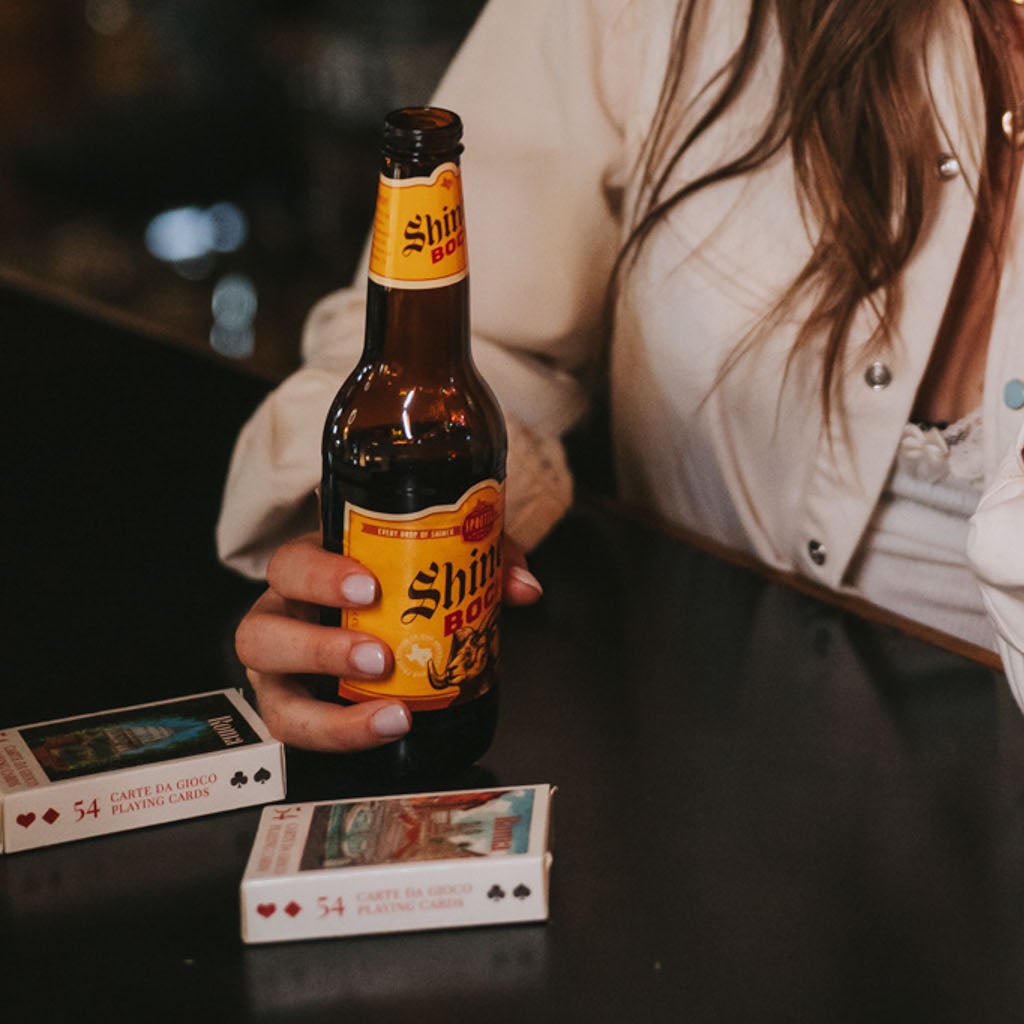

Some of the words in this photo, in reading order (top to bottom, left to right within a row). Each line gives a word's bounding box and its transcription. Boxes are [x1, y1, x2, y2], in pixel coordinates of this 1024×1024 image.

[73, 798, 101, 822] 54
[110, 785, 151, 803] CARTE
[155, 781, 174, 795] DA
[176, 773, 218, 790] GIOCO
[111, 796, 164, 816] PLAYING
[168, 786, 210, 805] CARDS
[317, 896, 345, 918] 54
